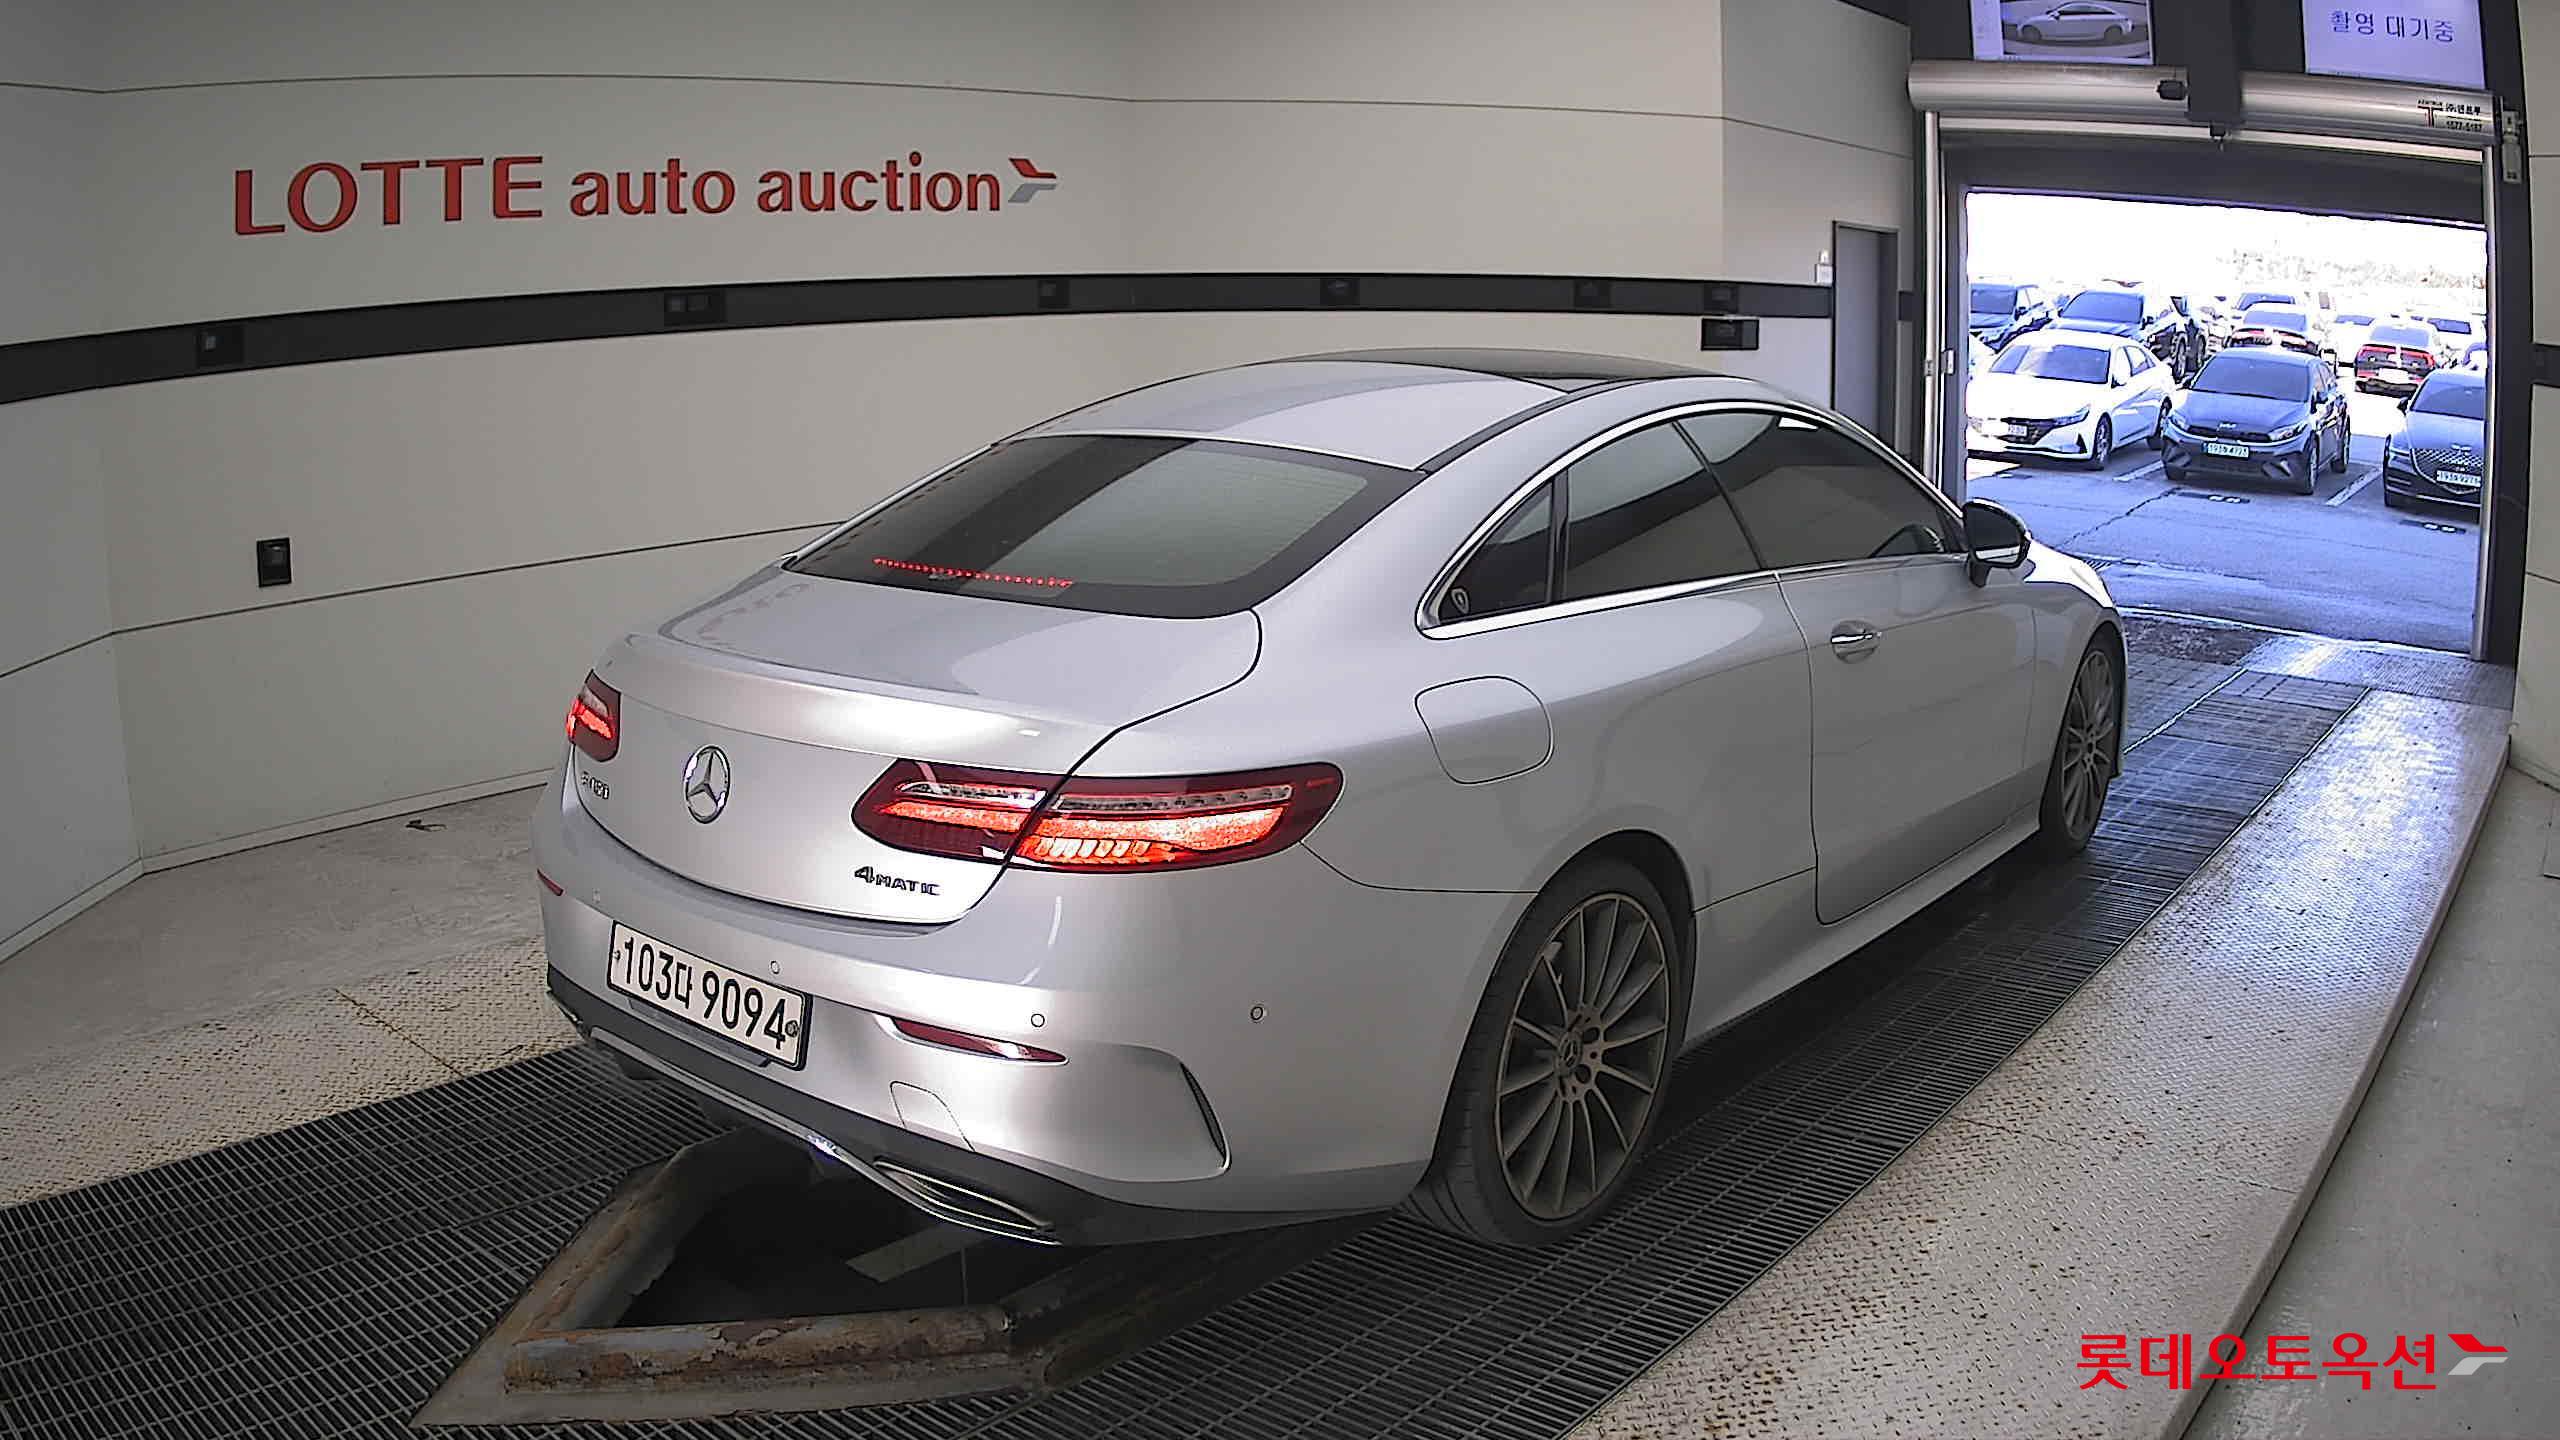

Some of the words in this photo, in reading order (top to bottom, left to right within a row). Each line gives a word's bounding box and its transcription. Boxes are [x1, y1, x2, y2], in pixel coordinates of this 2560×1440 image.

[2331, 10, 2375, 35] 촬영
[2386, 15, 2454, 43] 대기중
[235, 155, 544, 235] LOTTE
[569, 157, 736, 216] auto
[756, 151, 1002, 212] auction
[854, 866, 941, 896] 4MATIC
[624, 937, 693, 1010] 103다
[702, 970, 786, 1050] 9094
